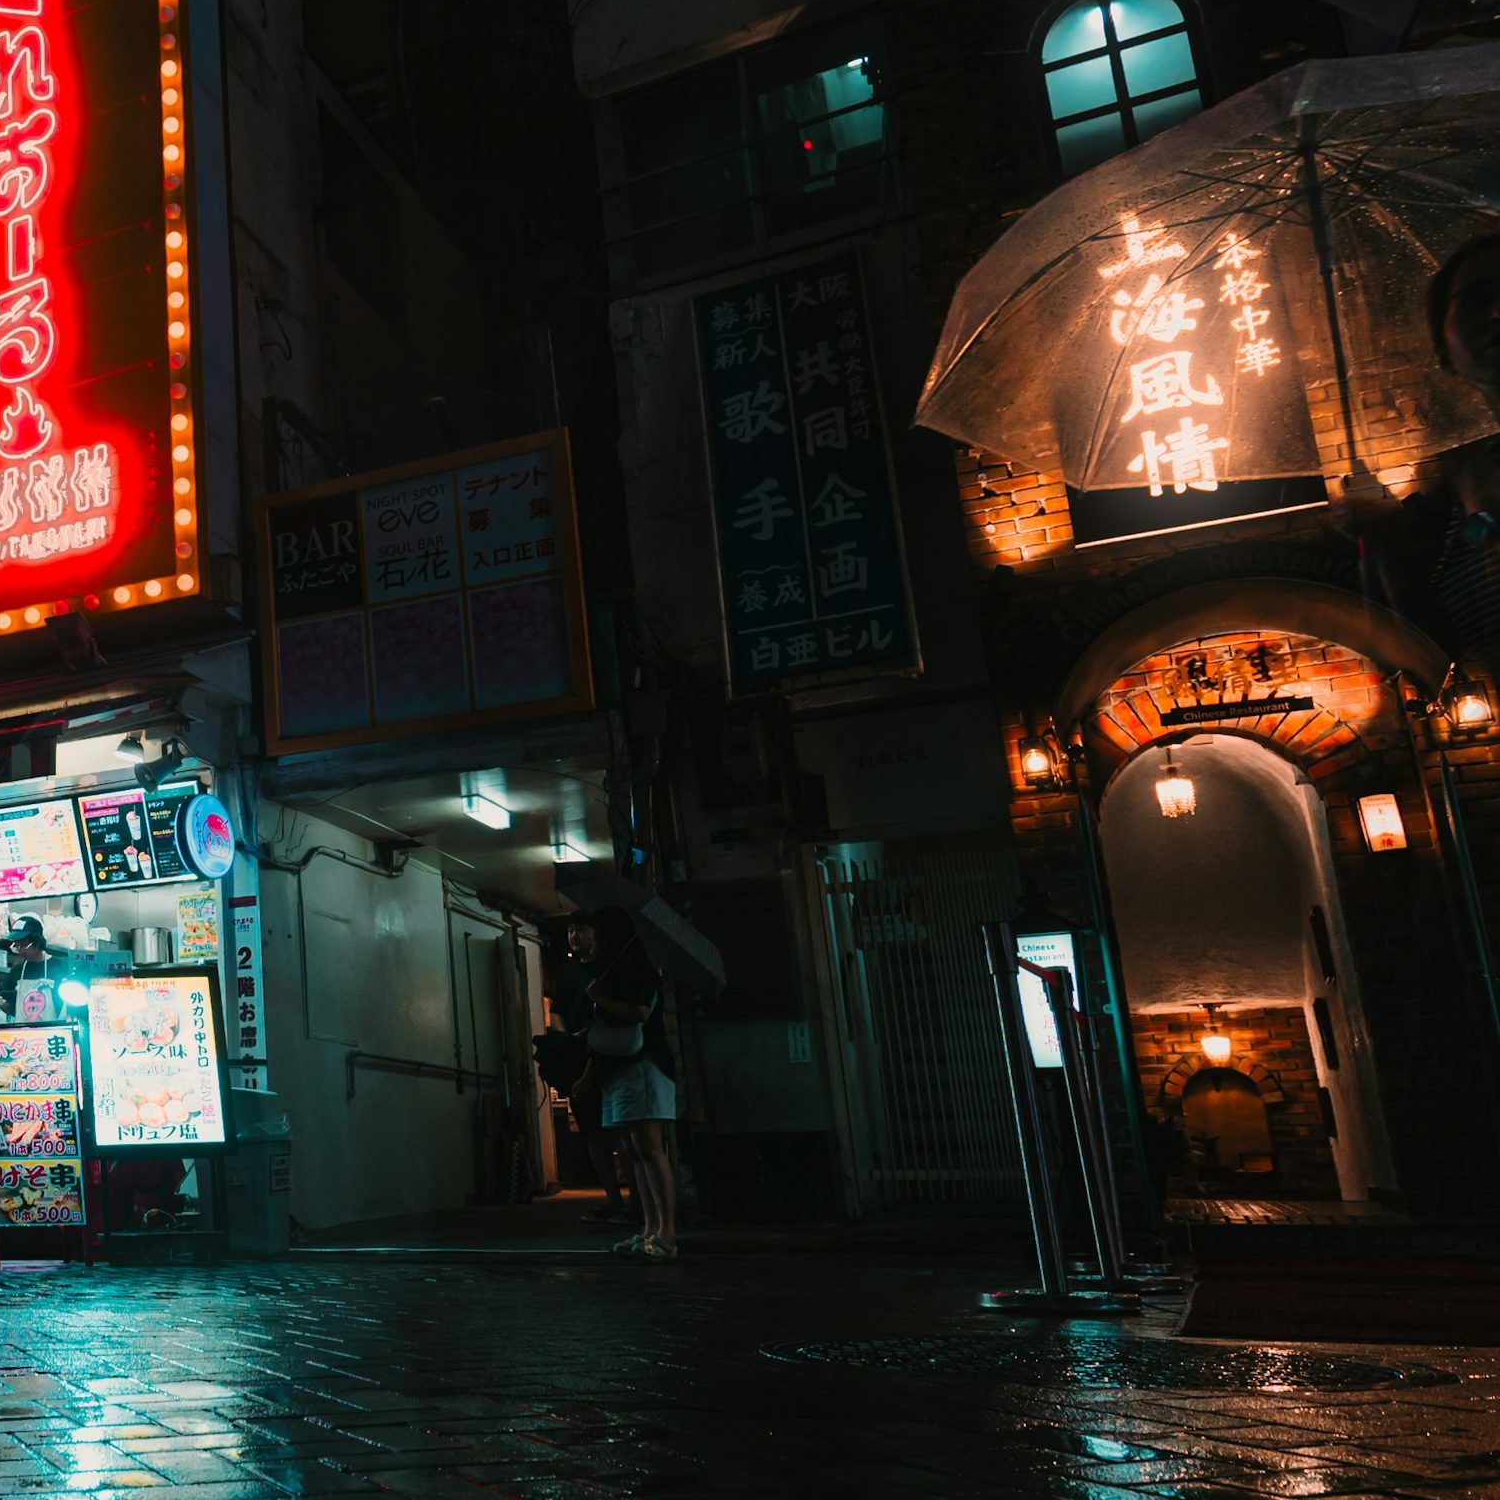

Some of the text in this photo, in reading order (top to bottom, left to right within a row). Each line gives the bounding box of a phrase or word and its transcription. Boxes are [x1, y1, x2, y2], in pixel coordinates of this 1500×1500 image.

[709, 290, 774, 332] 募集
[788, 272, 852, 313] 大阪
[1212, 232, 1282, 377] 本格中華
[712, 332, 778, 370] 新人
[719, 379, 795, 542] 歌手
[794, 339, 870, 599] 共同企画
[367, 483, 447, 509] NIGHT SPOT
[464, 465, 550, 500] テナント
[378, 500, 440, 534] eve
[275, 519, 357, 569] BAR
[378, 534, 446, 558] SOUL BAR
[471, 538, 556, 572] 入口正面
[736, 574, 806, 615] 養成
[749, 617, 894, 672] 白亜ビル
[1182, 701, 1291, 722] Chinese Restaurant
[1022, 943, 1056, 953] Chinese
[189, 990, 210, 1068] 外カリ中トロ
[112, 1042, 188, 1060] ソース味
[117, 1124, 199, 1141] トリュフ塩
